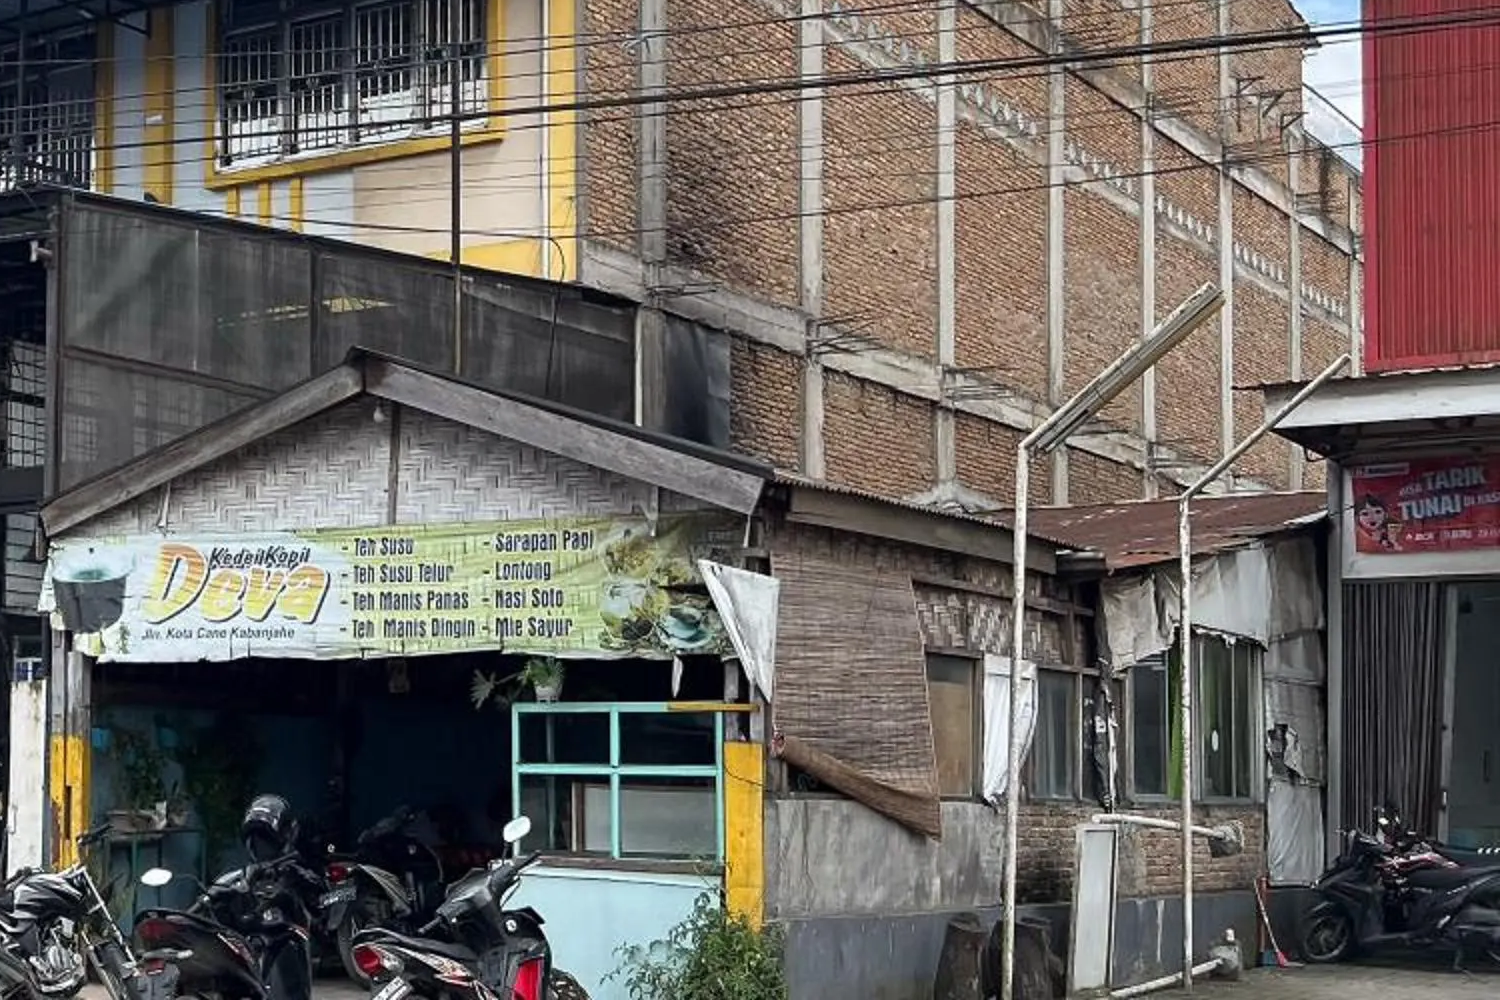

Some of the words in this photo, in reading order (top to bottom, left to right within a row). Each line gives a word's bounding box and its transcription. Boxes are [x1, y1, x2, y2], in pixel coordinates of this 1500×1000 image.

[1422, 467, 1486, 491] TARIK
[1397, 494, 1462, 521] TUNAI
[353, 538, 377, 557] Teh
[380, 537, 414, 556] Susu
[495, 532, 557, 553] Sarapan
[563, 530, 594, 550] Pagi
[353, 564, 375, 583] Teh
[380, 564, 413, 583] Susu
[418, 563, 454, 582] Telur
[495, 561, 551, 581] Lontong
[141, 542, 331, 625] Deva
[353, 591, 375, 611] Teh
[380, 591, 422, 611] Manis
[427, 591, 469, 610] Panas
[495, 589, 526, 609] Nasi
[531, 588, 564, 608] Soto
[165, 627, 193, 639] Kota
[197, 627, 228, 639] Cane
[229, 627, 296, 642] Kabanjahe
[352, 619, 374, 639] Teh
[384, 619, 426, 639] Manis
[431, 618, 475, 639] Dingin
[495, 618, 523, 637] Mie
[528, 616, 573, 638] Sayur
